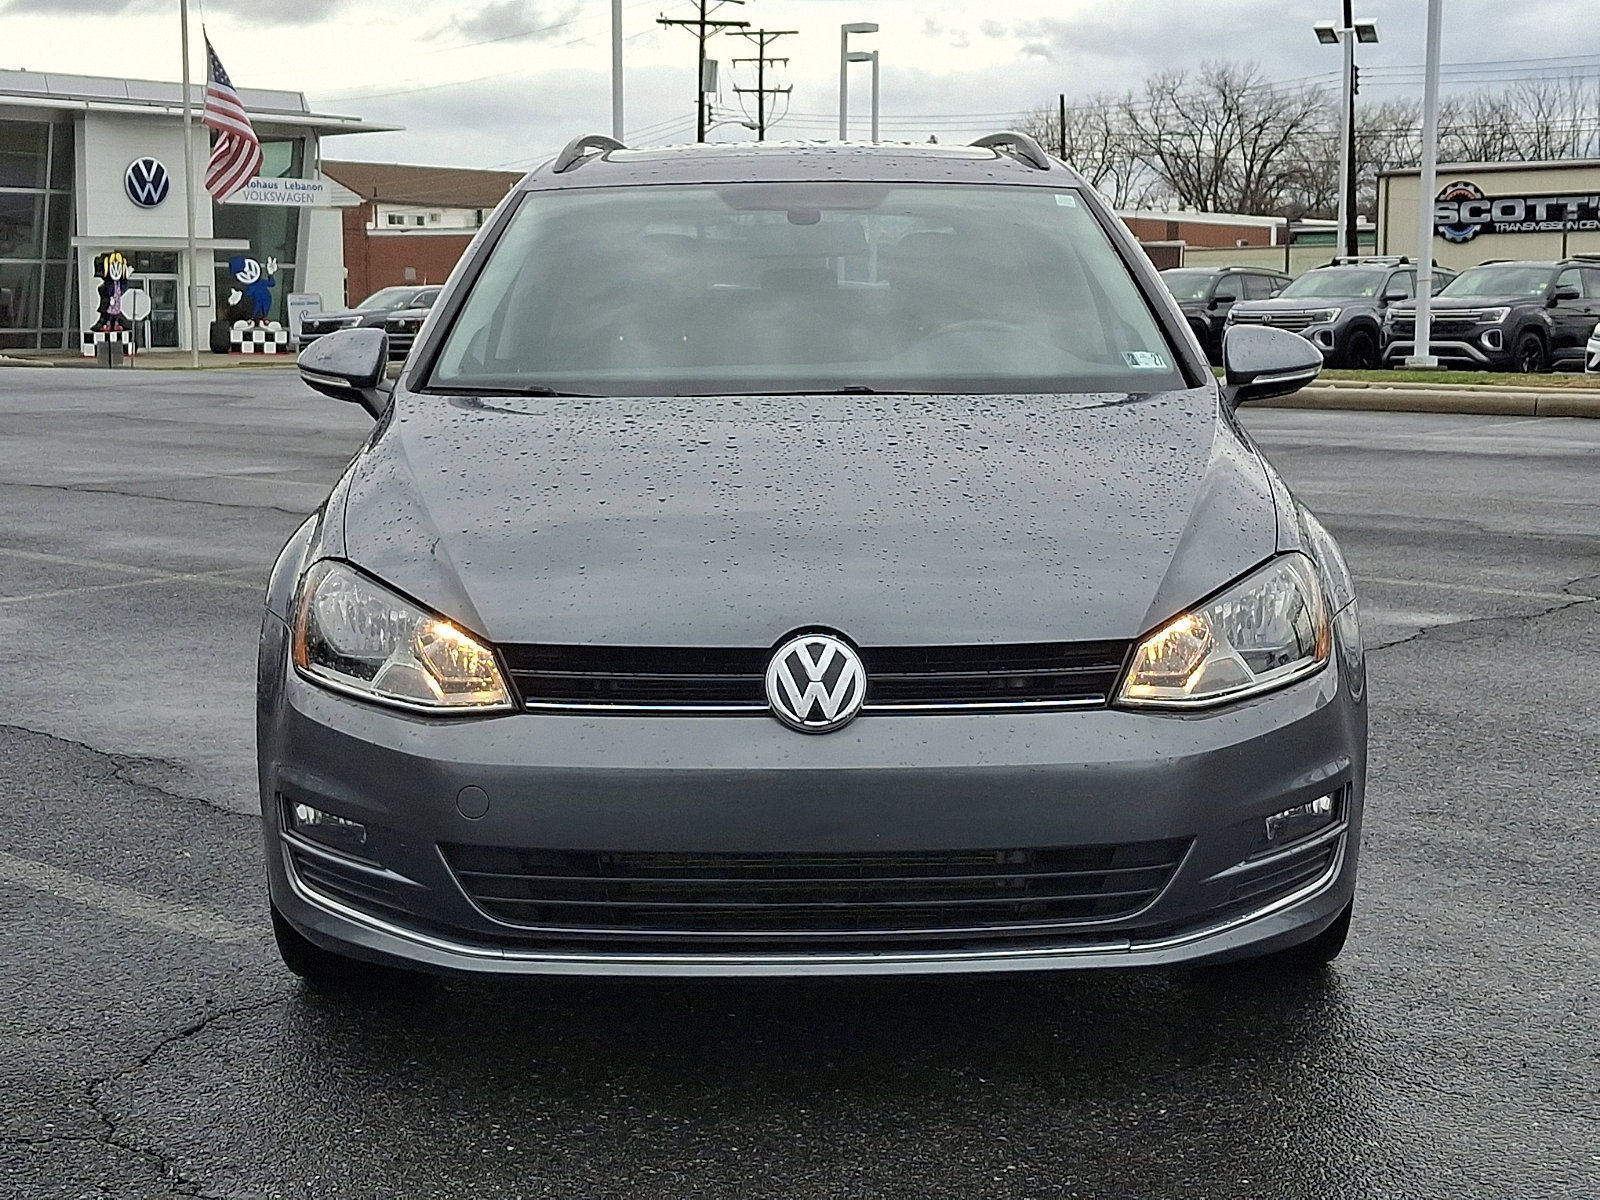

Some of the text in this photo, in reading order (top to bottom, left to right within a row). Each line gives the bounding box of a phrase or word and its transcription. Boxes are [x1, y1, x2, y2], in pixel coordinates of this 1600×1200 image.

[126, 158, 168, 206] VW
[246, 179, 324, 192] ohaus Lebanon
[243, 190, 315, 204] VOLKSWAGEN
[1434, 196, 1600, 225] SCOTT'
[768, 635, 864, 728] VW
